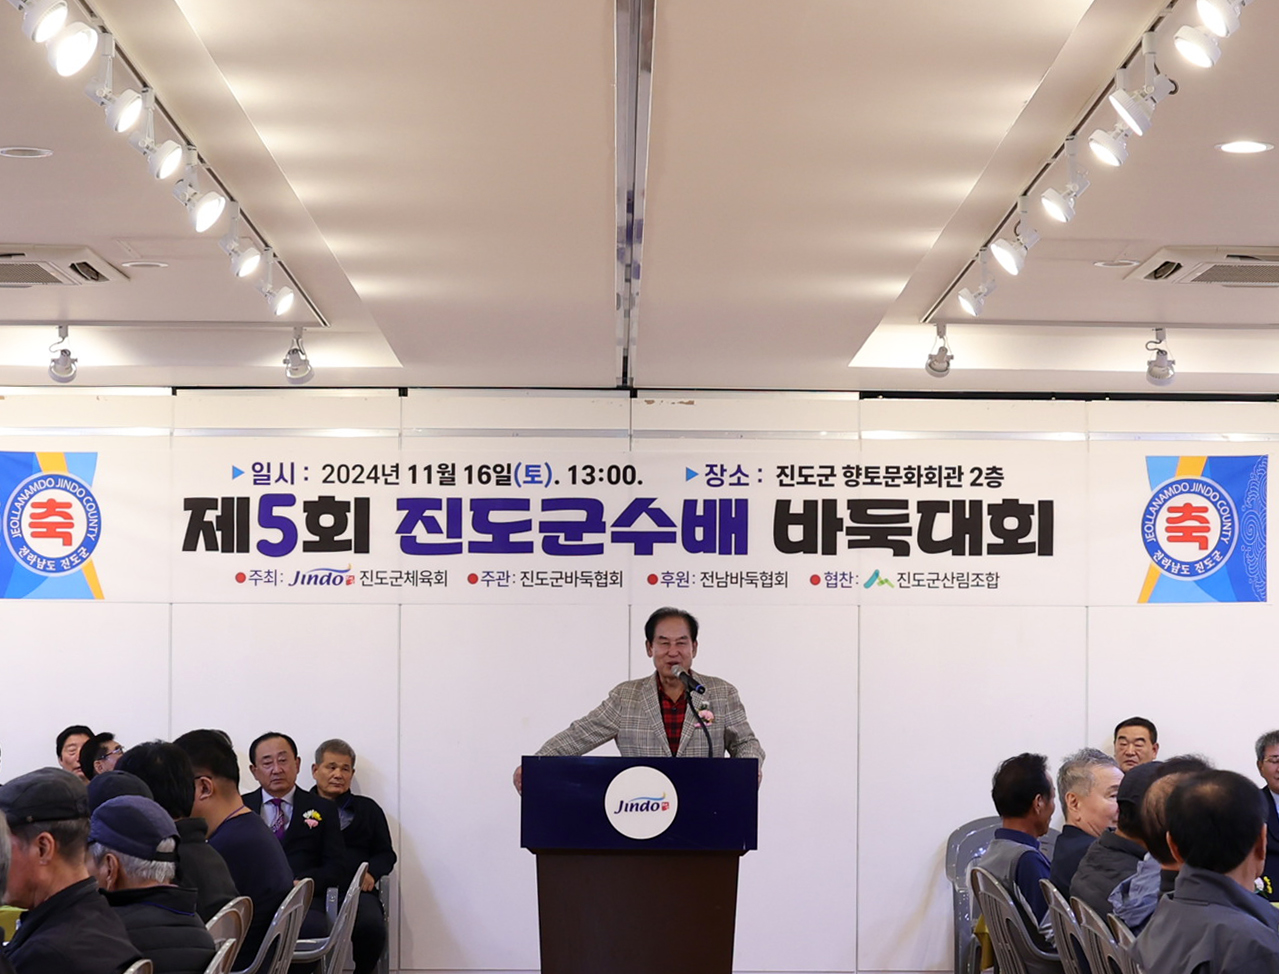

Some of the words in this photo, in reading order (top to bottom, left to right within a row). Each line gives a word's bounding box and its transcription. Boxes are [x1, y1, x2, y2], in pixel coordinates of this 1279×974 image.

[321, 463, 401, 486] 2024년
[407, 463, 457, 486] 11월
[463, 462, 561, 488] 16일(토).
[567, 464, 643, 485] 13:00.
[776, 464, 837, 488] 진도군
[842, 464, 964, 488] 향토문화회관
[969, 465, 1005, 488] 2층
[10, 477, 54, 538] JEOLLANAMDO
[56, 478, 86, 497] JINDO
[83, 496, 99, 541] COUNTY
[1144, 482, 1190, 543] JEOLLANAMDO
[1190, 482, 1220, 502] JINDO
[1217, 500, 1232, 545] COUNTY
[28, 498, 75, 546] 축
[182, 493, 370, 558] 제5회
[395, 496, 749, 556] 진도군수배
[773, 498, 1054, 558] 바둑대회
[1165, 502, 1211, 550] 축
[18, 545, 56, 571] 전라남도
[61, 546, 90, 571] 진도군
[1153, 550, 1191, 575] 전라남도
[1194, 550, 1224, 574] 진도군
[248, 570, 284, 587] 주최:
[288, 570, 344, 587] Jindo
[359, 570, 448, 587] 진도군체육회
[480, 570, 516, 587] 주관:
[520, 570, 623, 588] 진도군바둑협회
[660, 571, 696, 588] 후원:
[700, 570, 789, 588] 전남바둑협회
[824, 571, 859, 588] 협찬:
[897, 571, 1000, 589] 진도군산림조합
[614, 800, 660, 815] Jindo
